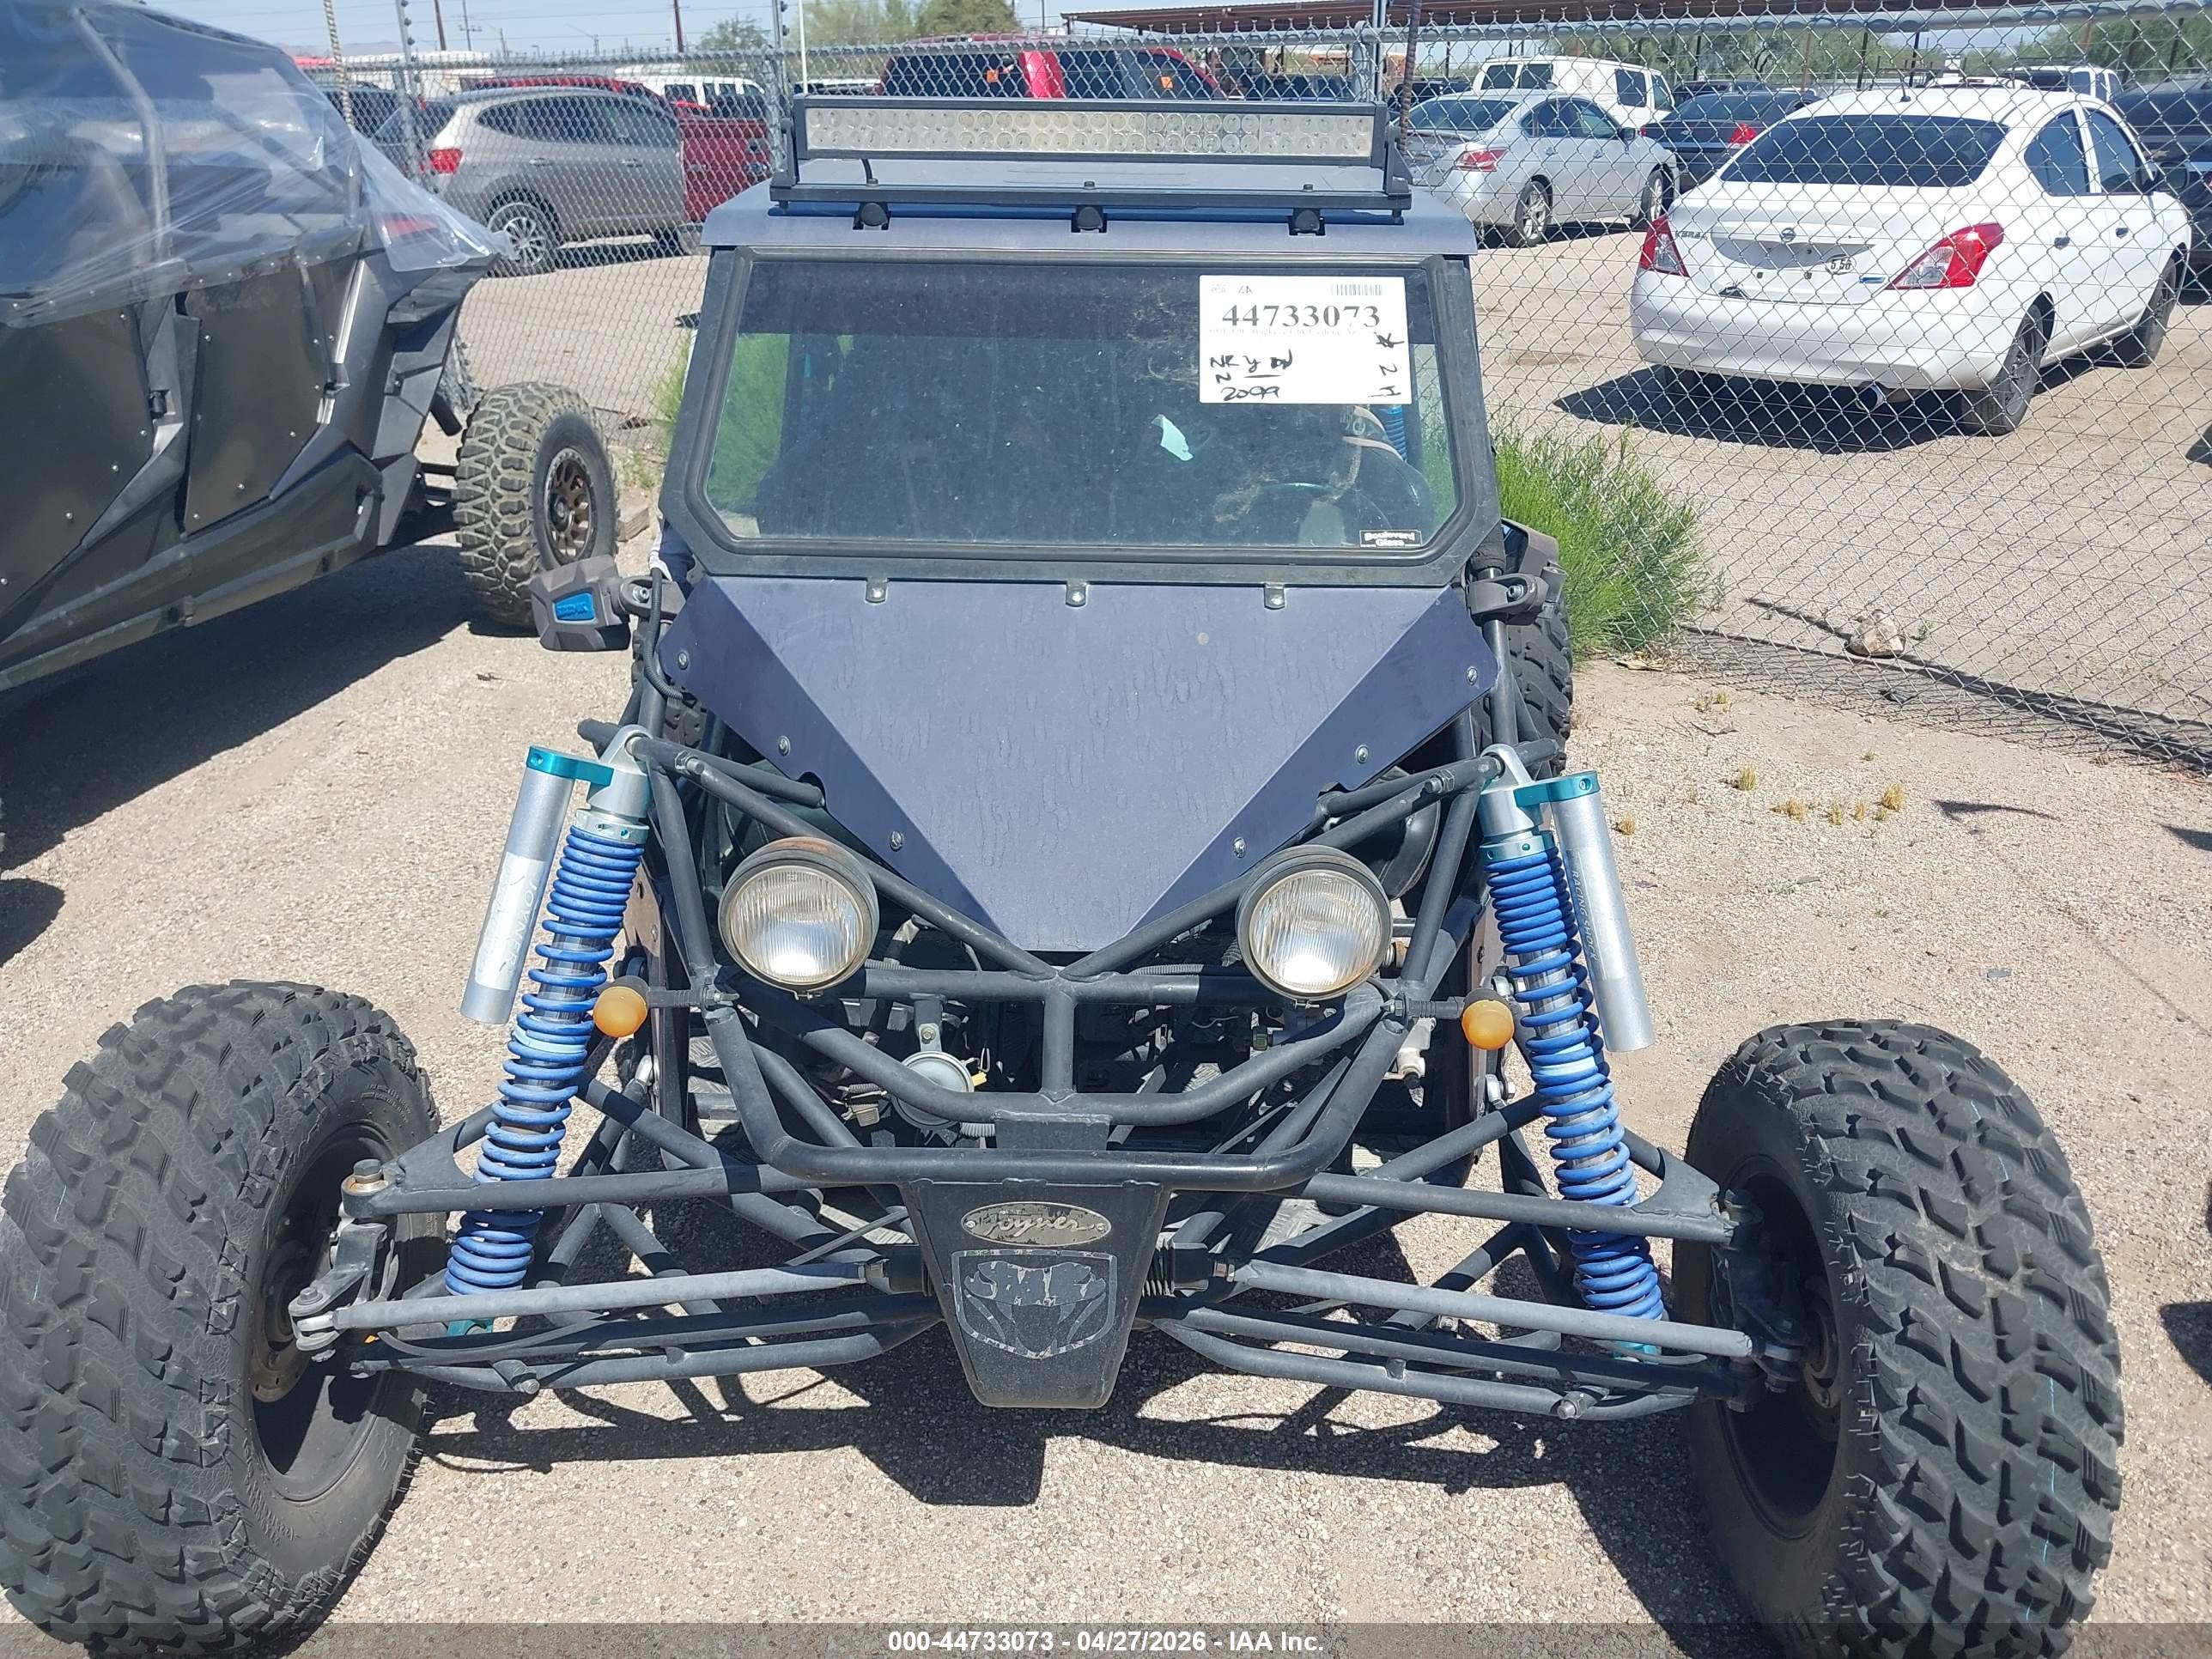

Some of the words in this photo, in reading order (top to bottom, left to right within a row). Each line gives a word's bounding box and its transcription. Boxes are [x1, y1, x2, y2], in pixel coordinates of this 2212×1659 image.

[1221, 304, 1381, 328] 44733073
[1571, 871, 1588, 917] RACING
[1583, 920, 1598, 963] SHOCK
